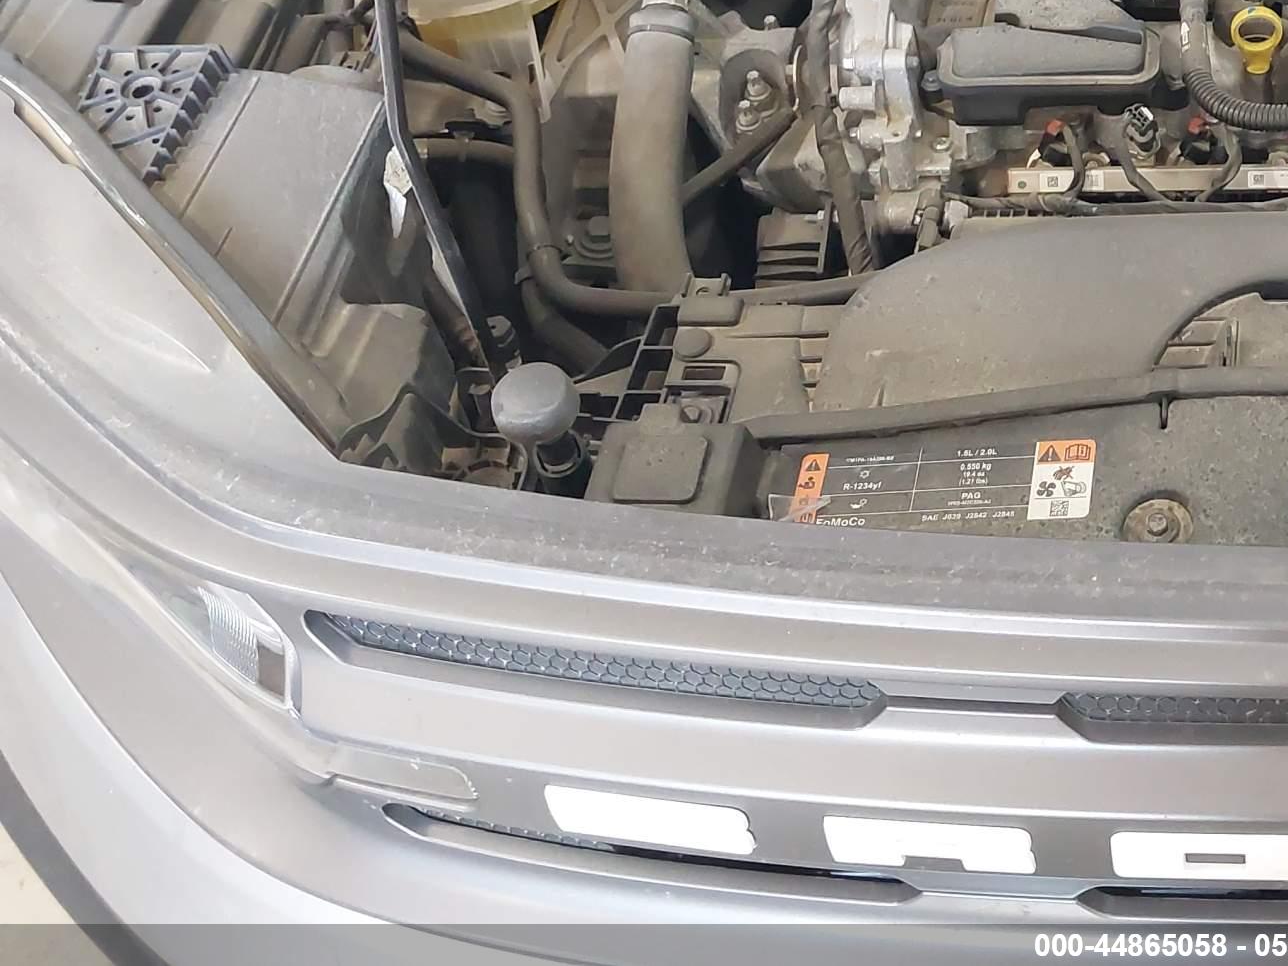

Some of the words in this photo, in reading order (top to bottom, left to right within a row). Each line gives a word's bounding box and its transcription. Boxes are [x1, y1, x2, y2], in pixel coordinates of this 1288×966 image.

[979, 447, 998, 456] 2.0L
[842, 481, 882, 491] R-1234yf
[961, 491, 981, 500] PAG
